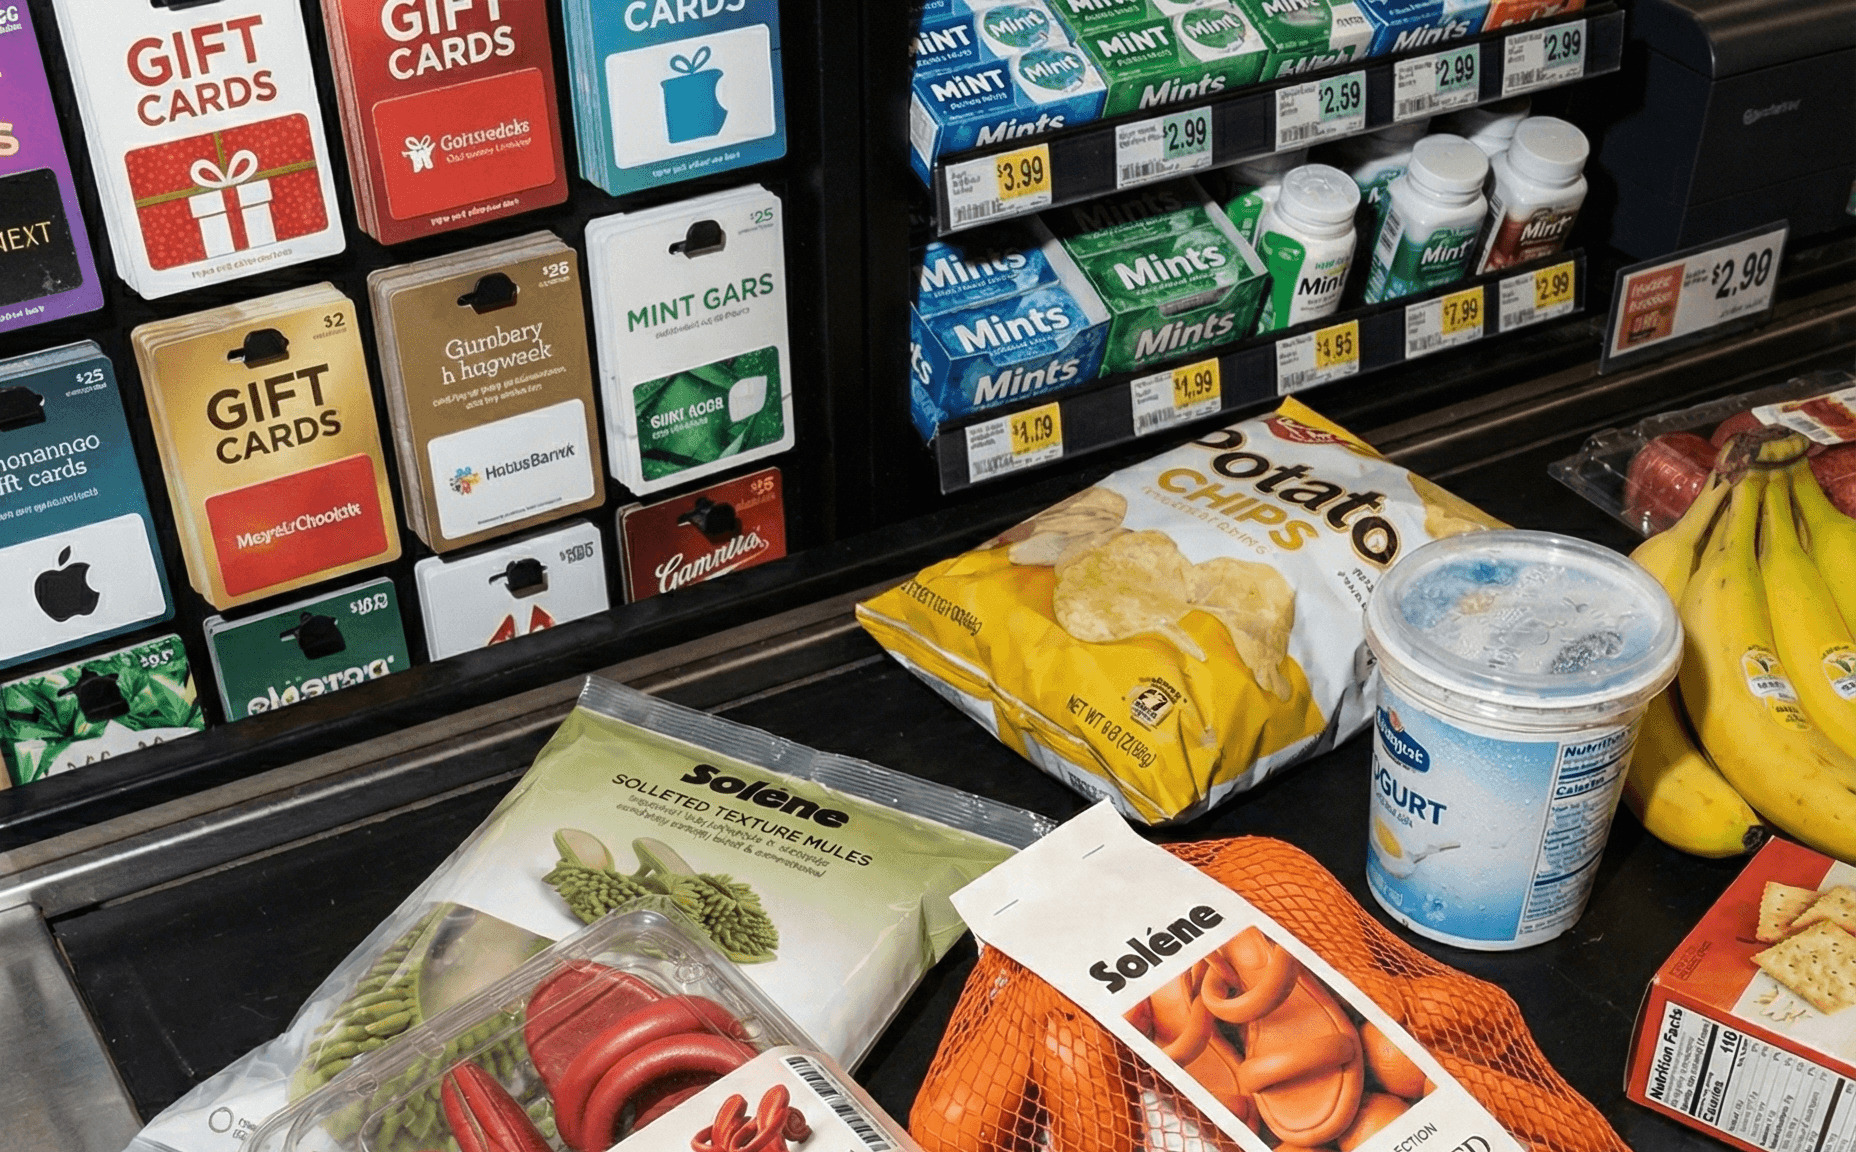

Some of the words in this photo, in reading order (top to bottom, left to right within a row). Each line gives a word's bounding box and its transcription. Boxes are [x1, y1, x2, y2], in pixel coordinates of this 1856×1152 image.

[126, 15, 263, 87] GIFT
[388, 25, 515, 80] CARDS
[1392, 19, 1471, 53] Mints
[1544, 29, 1581, 62] $2.99
[1138, 73, 1227, 110] Mints
[1435, 53, 1475, 87] $2.99
[136, 70, 277, 127] CARDS
[1318, 80, 1361, 115] $2.59
[975, 113, 1065, 148] Mints
[1162, 116, 1207, 151] $2.99
[997, 155, 1045, 192] $3.99
[1113, 246, 1227, 291] Mints
[1711, 247, 1773, 300] $2.99
[627, 294, 695, 333] MINT
[953, 307, 1070, 353] Mints
[1134, 313, 1236, 360] Mints
[206, 363, 330, 431] GIFT
[973, 358, 1080, 406] Mints
[215, 409, 342, 465] CARDS
[28, 457, 88, 487] cards
[1158, 468, 1319, 551] CHIPS
[611, 773, 710, 812] SOLLETED
[714, 804, 803, 843] TEXTURE
[803, 835, 873, 867] MULES
[1089, 905, 1225, 995] Soléne
